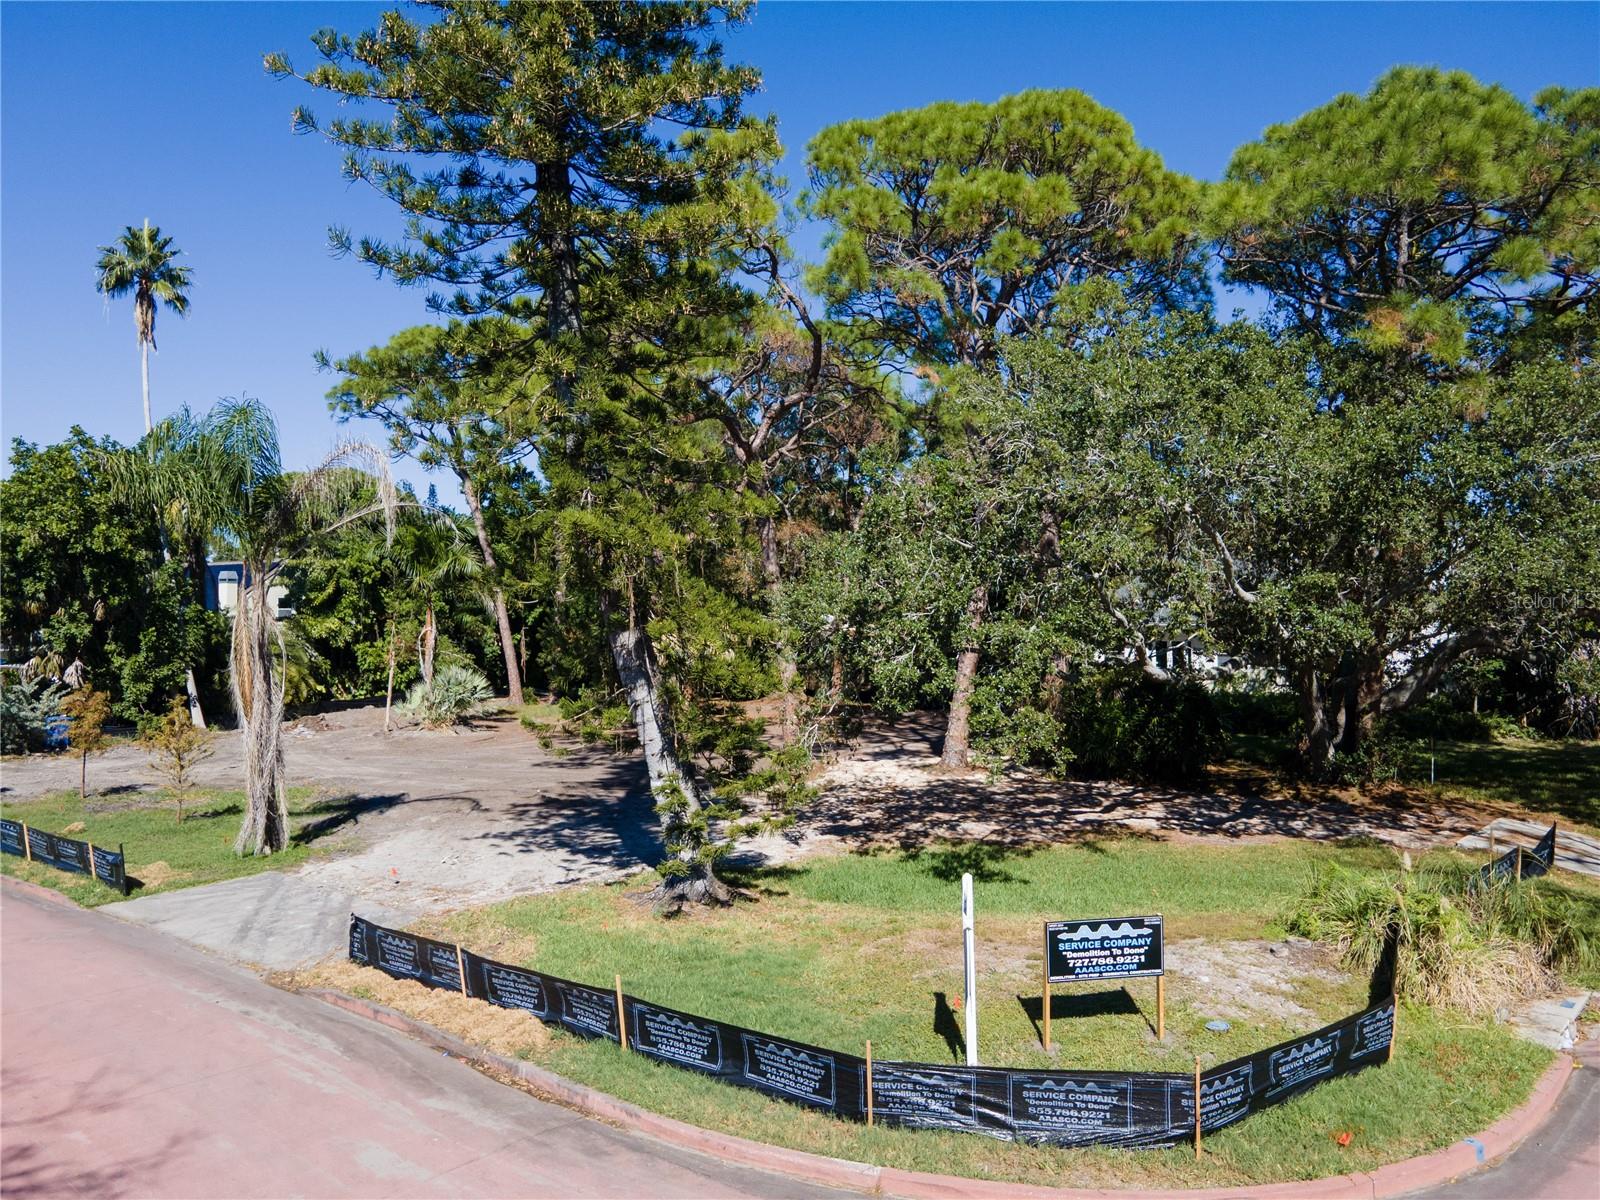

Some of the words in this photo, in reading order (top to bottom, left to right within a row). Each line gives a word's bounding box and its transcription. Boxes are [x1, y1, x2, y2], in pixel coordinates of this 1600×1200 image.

[1058, 940, 1101, 950] SERVICE
[1104, 938, 1152, 948] COMPANY
[1062, 949, 1110, 958] "Demolition
[1067, 955, 1145, 967] 727.786.9221
[1074, 964, 1137, 974] AAASCO.COM
[645, 1020, 676, 1032] SERVICE
[678, 1029, 712, 1042] COMPANY
[658, 1044, 702, 1059] AAASCO.COM
[754, 1049, 786, 1064] SERVICE
[788, 1060, 825, 1076] COMPANY
[1278, 1057, 1304, 1074] SERVICE
[1304, 1045, 1332, 1062] COMPANY
[766, 1073, 813, 1092] AAASCO.COM
[872, 1082, 914, 1090] SERVICE
[1022, 1091, 1066, 1100] SERVICE
[1068, 1094, 1118, 1104] COMPANY
[1216, 1084, 1244, 1100] COMPANY
[1025, 1098, 1074, 1108] "Demolition
[1028, 1107, 1110, 1118] 855.786.9221
[1038, 1116, 1102, 1126] AAASCO.COM
